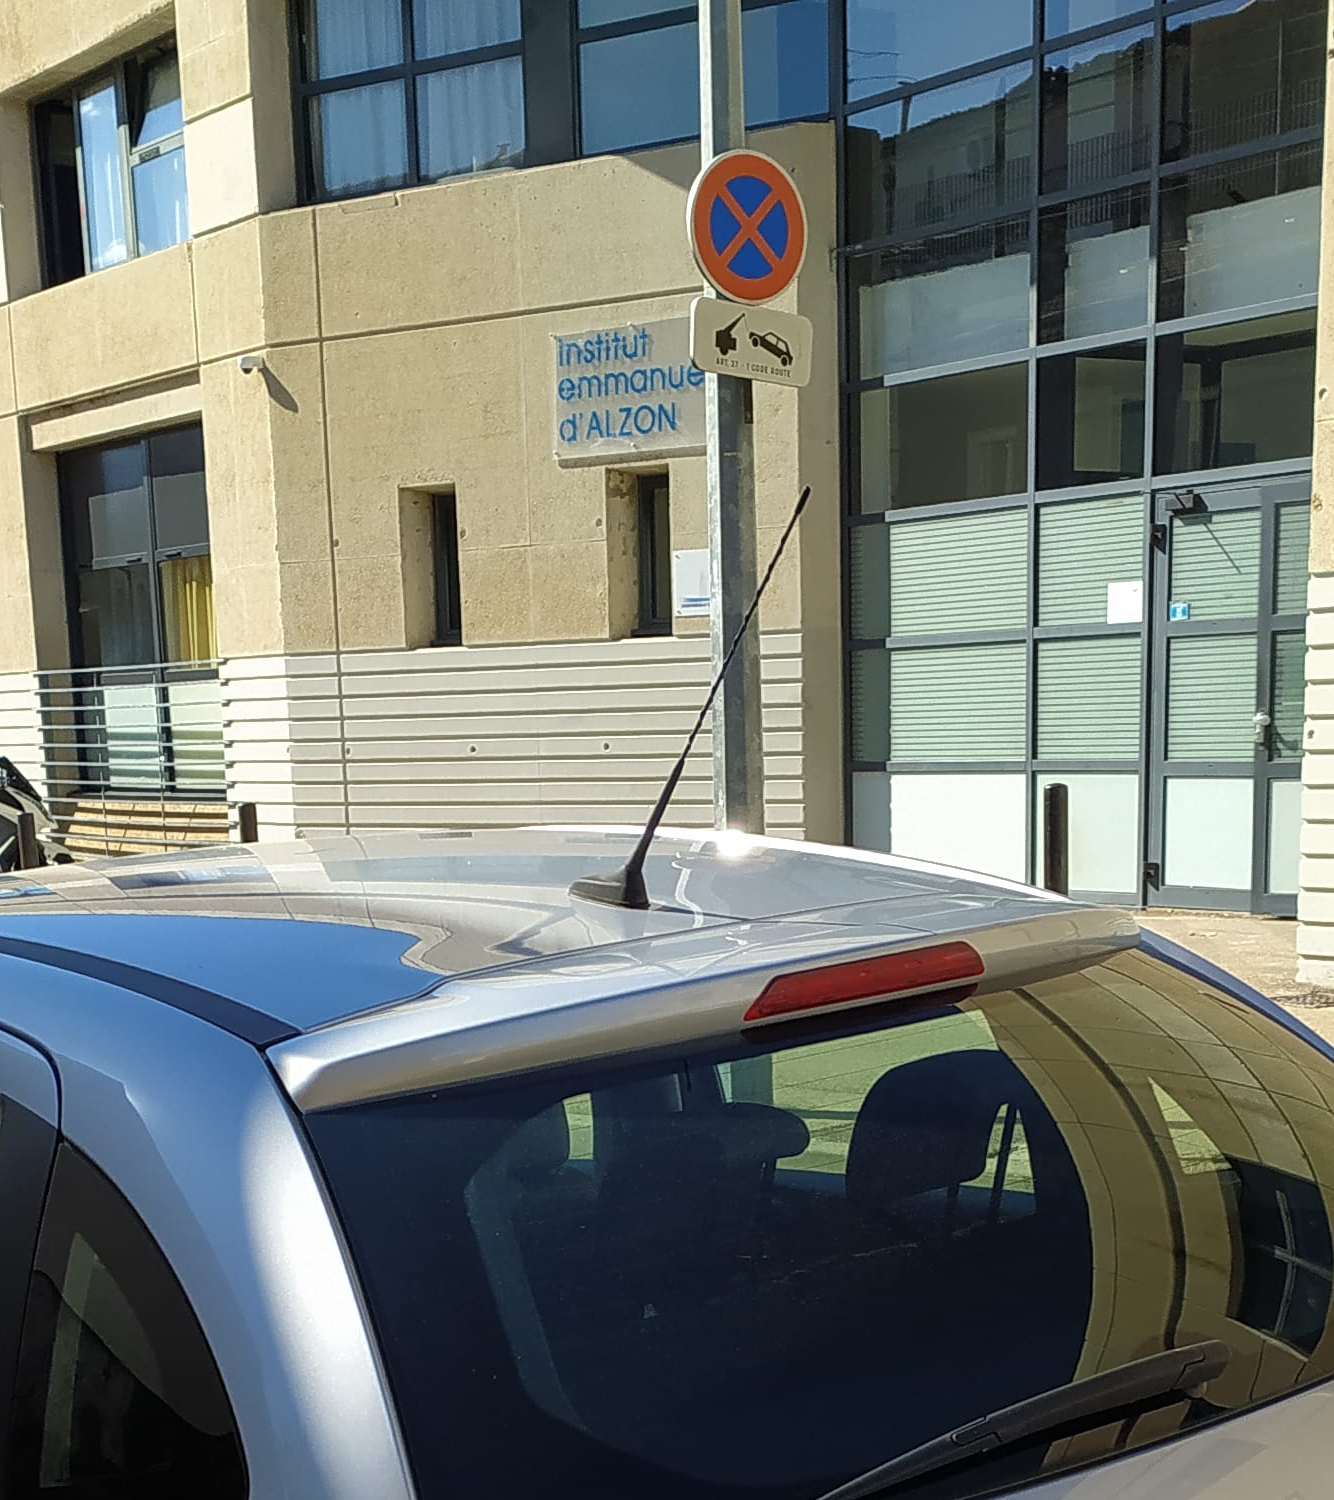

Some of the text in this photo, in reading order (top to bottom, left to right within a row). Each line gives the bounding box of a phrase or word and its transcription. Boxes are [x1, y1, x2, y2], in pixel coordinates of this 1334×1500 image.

[558, 327, 649, 367] institut
[558, 364, 706, 402] emmanue
[750, 363, 769, 374] CODE
[770, 366, 791, 378] ROUTE
[559, 402, 677, 442] d'ALZON
